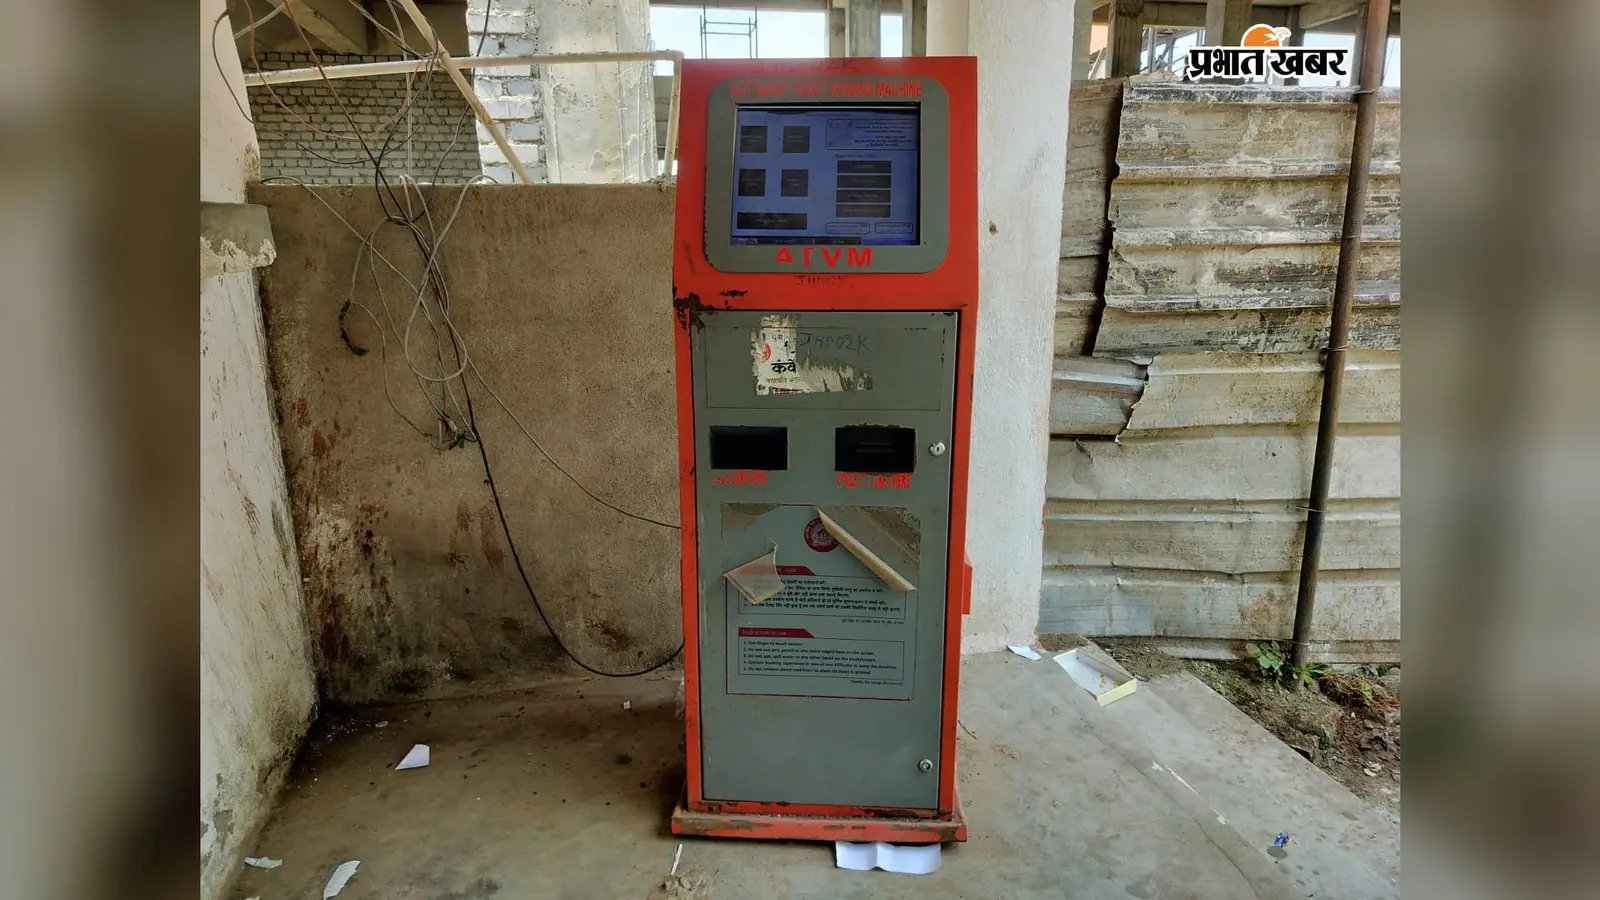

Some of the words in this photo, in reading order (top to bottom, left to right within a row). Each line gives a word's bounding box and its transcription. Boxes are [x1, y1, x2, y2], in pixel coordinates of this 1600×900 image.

[792, 82, 826, 97] TICKET
[828, 82, 875, 97] VENDING
[876, 81, 923, 97] MACHINE
[775, 246, 873, 268] ATVM
[892, 474, 911, 489] HERE
